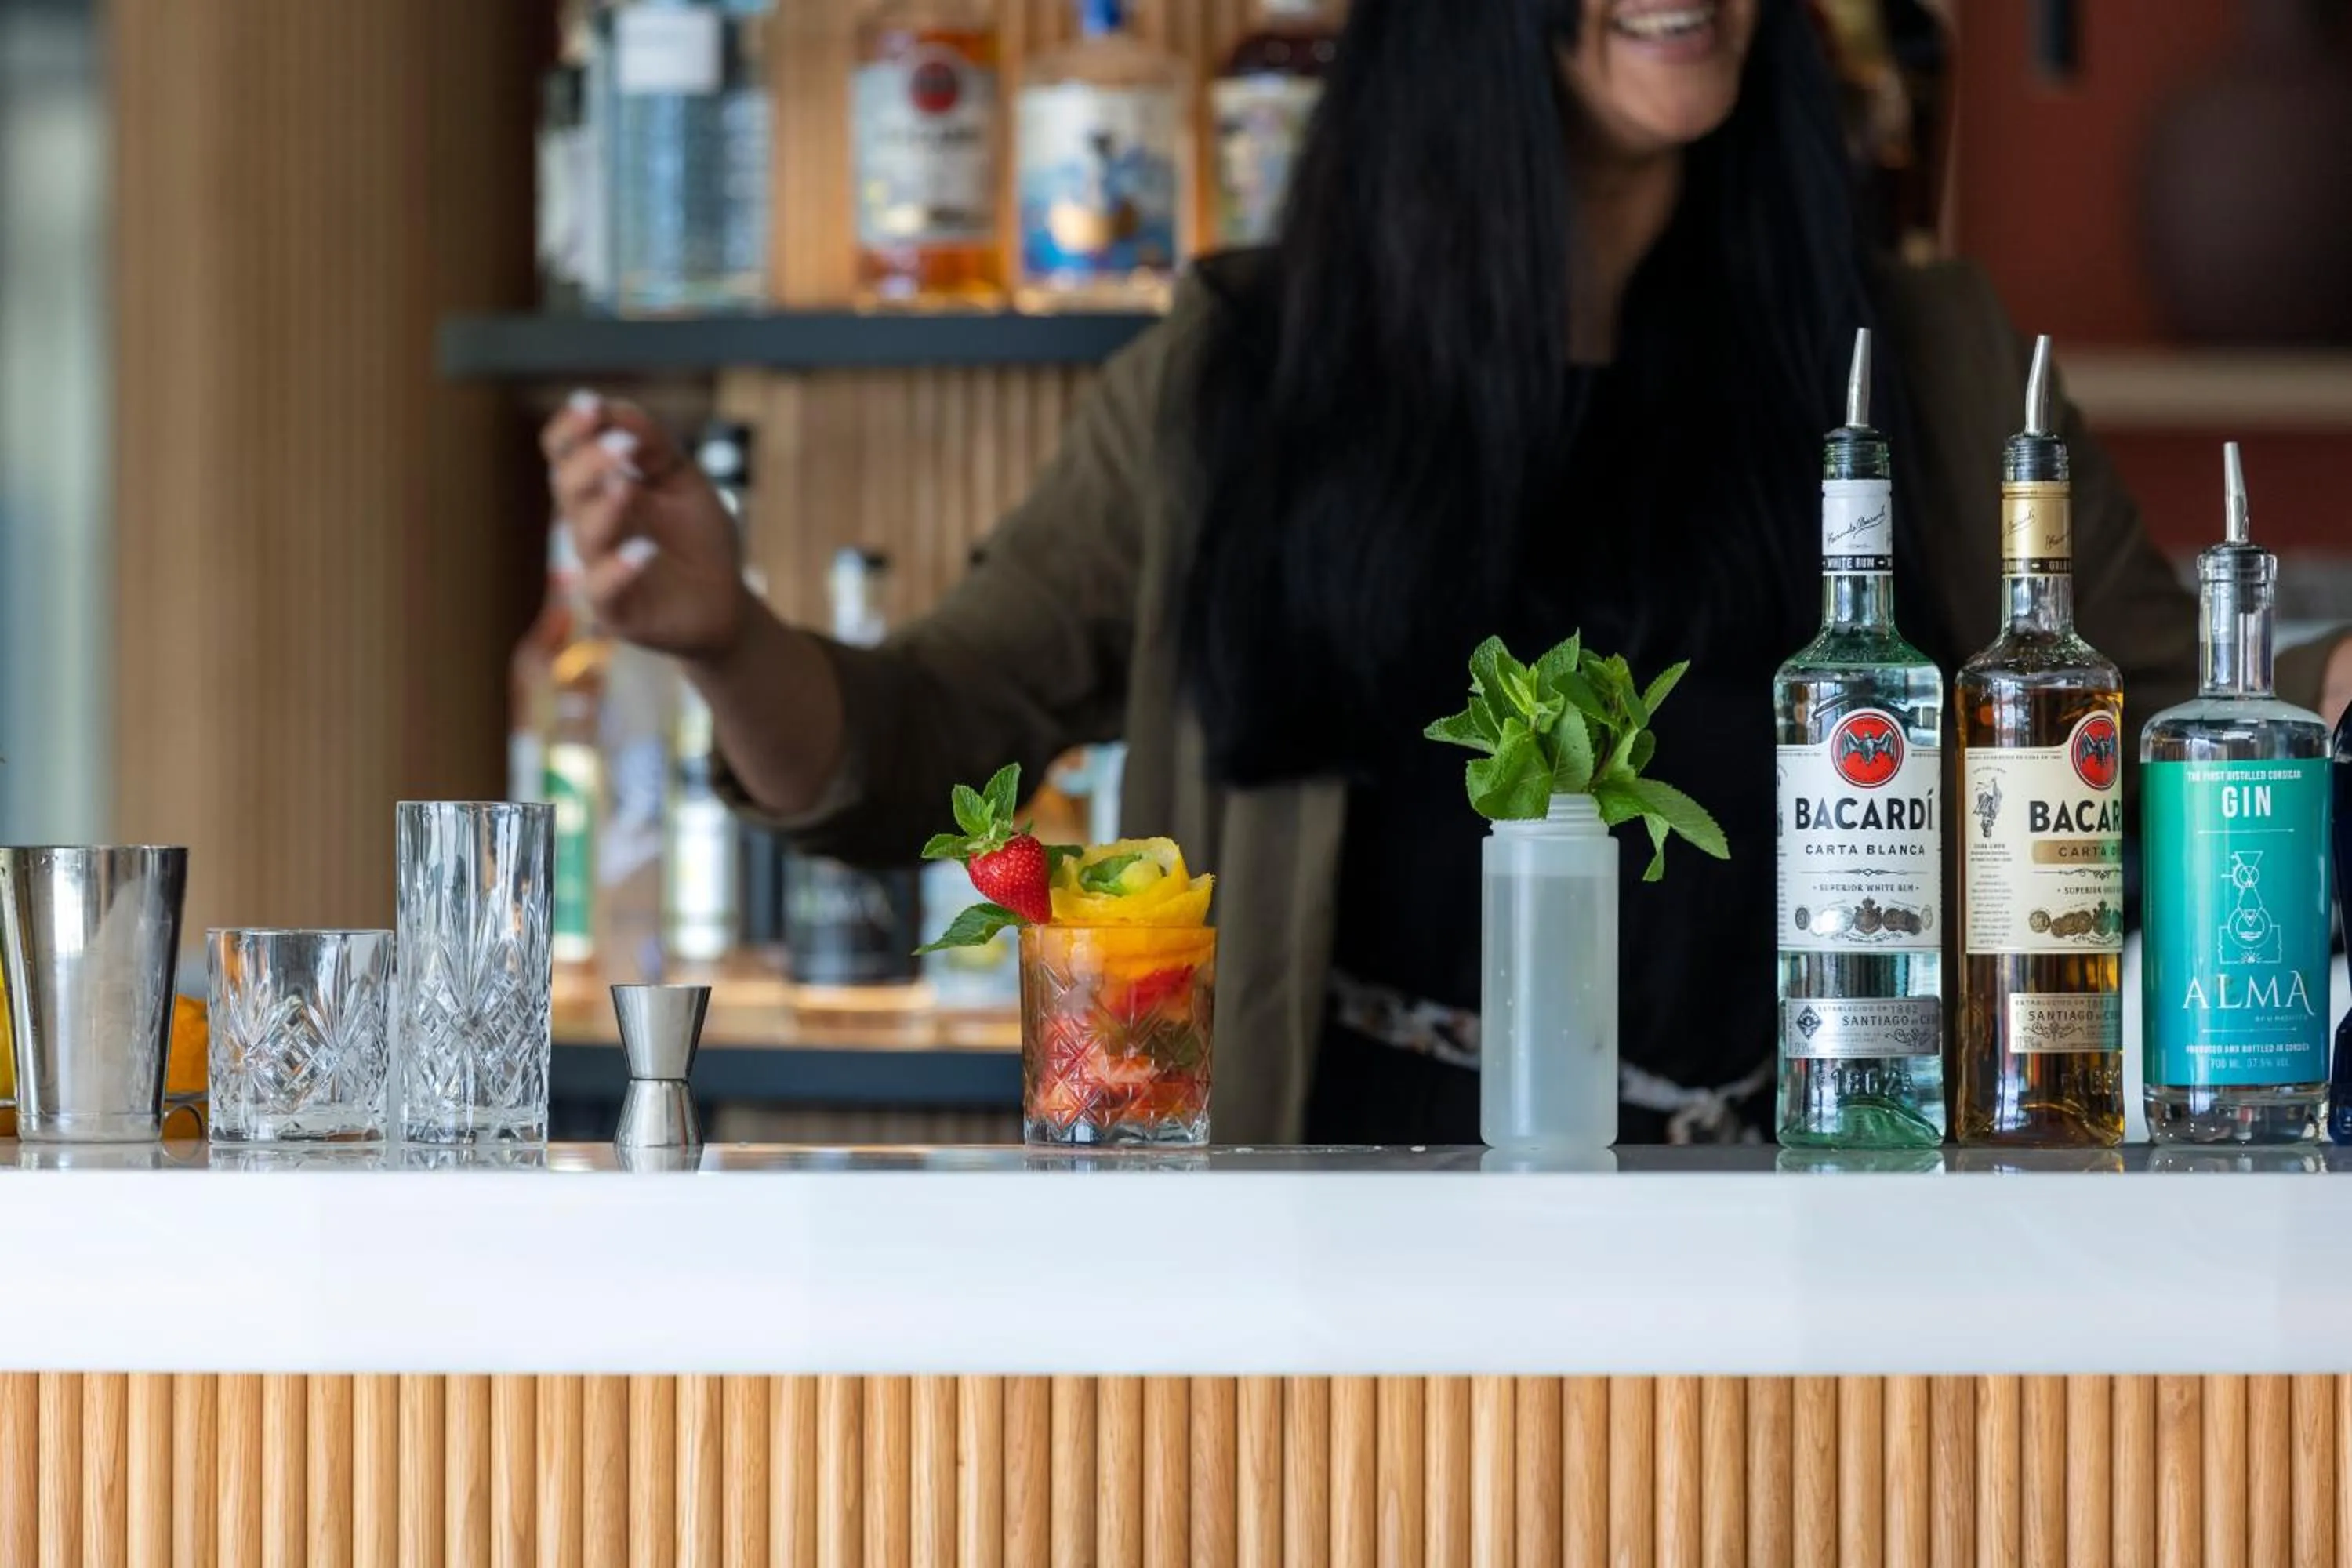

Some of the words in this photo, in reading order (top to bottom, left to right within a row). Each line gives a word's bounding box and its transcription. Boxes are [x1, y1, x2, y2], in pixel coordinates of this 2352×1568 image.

[2227, 771, 2267, 781] DISTILLED
[2222, 786, 2272, 818] GIN
[1795, 787, 1933, 831] BACARDÍ
[2029, 800, 2122, 833] BACAR
[1806, 844, 1858, 855] CARTA
[1867, 844, 1926, 855] BLANCA
[2058, 846, 2107, 857] CARTA
[2182, 969, 2316, 1017] ALMA
[1842, 1015, 1909, 1027] SANTIAGO
[2028, 1010, 2094, 1022] SANTIAGO
[2224, 1044, 2240, 1054] AND
[2241, 1044, 2274, 1054] BOTTLED
